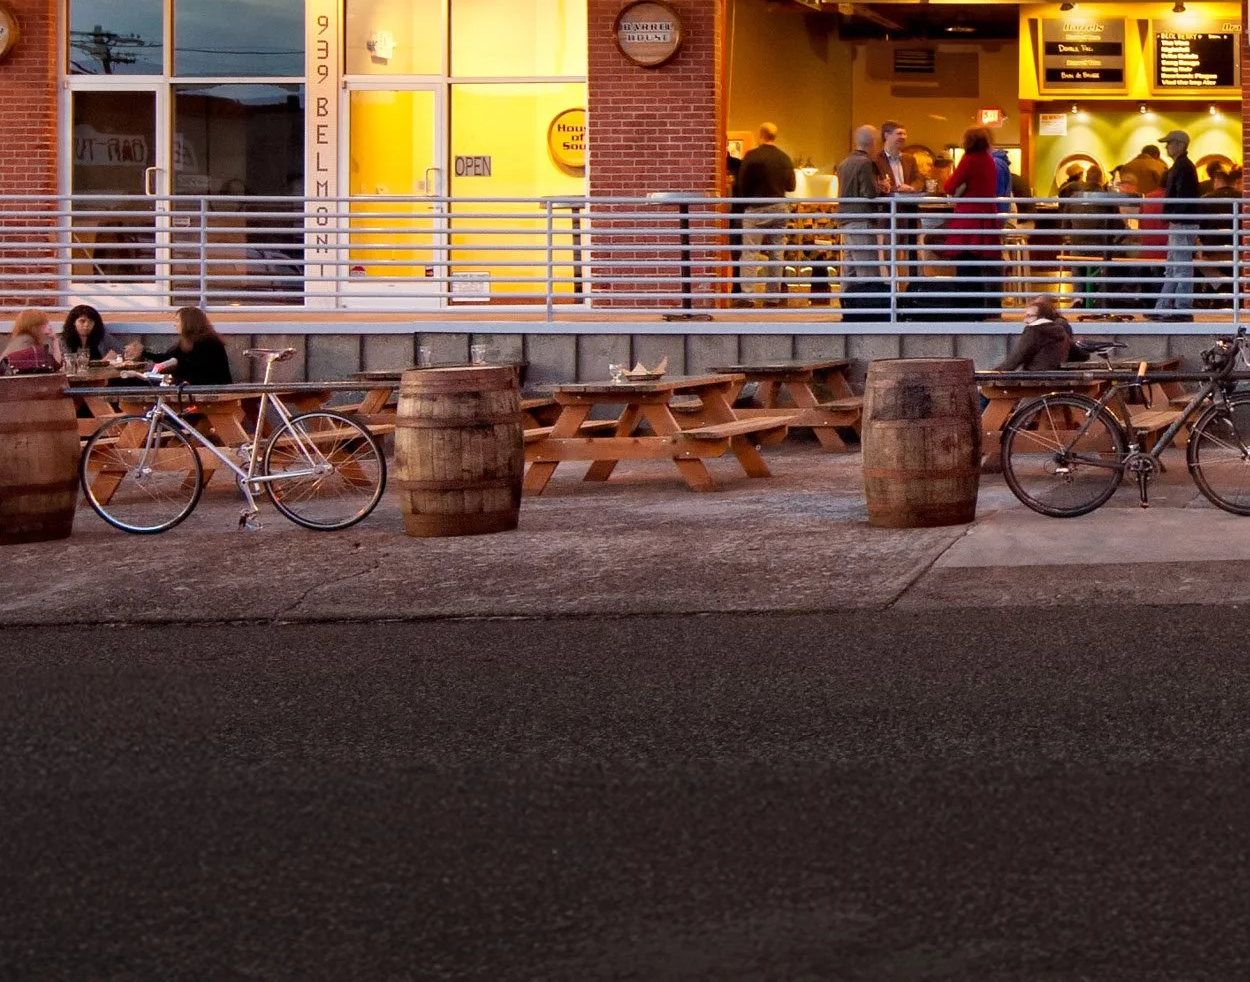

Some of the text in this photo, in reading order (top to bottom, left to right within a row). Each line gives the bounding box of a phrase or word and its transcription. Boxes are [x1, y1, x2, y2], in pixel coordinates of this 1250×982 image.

[317, 15, 329, 84] 939
[571, 133, 585, 141] of
[454, 156, 492, 177] OPEN
